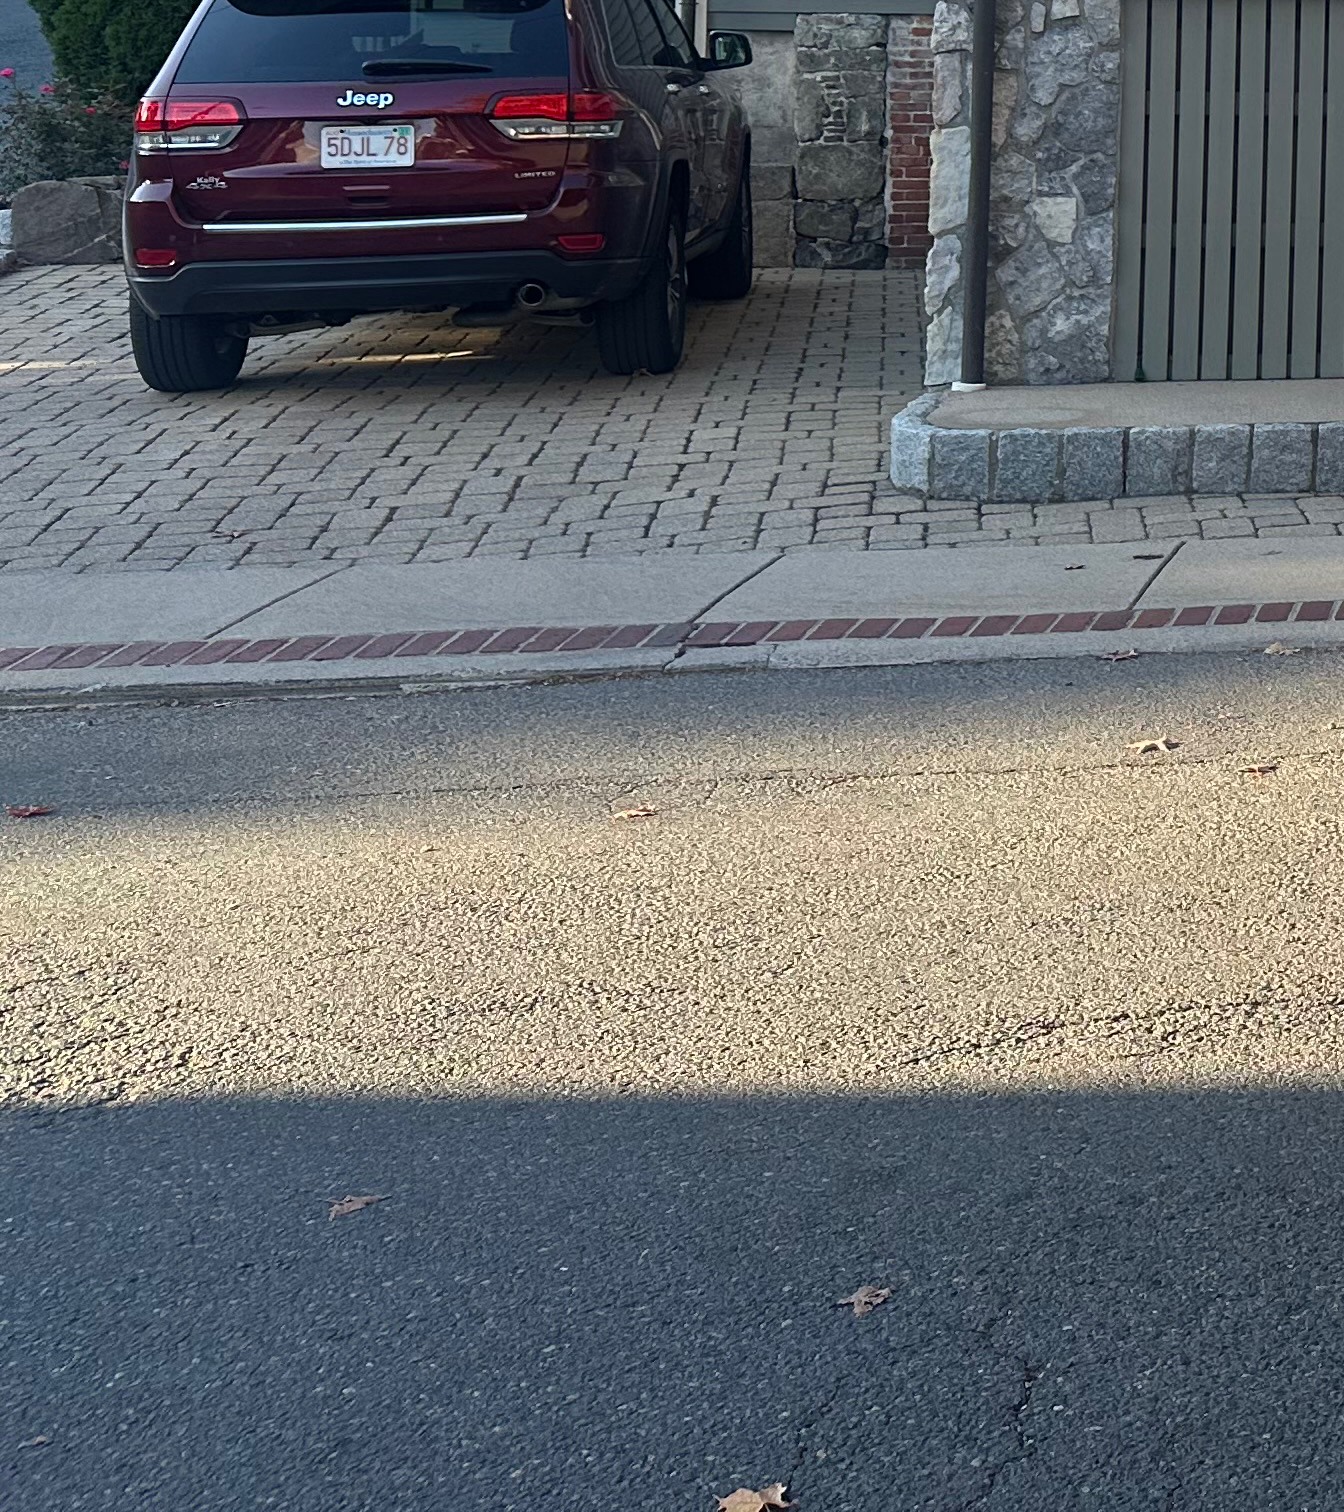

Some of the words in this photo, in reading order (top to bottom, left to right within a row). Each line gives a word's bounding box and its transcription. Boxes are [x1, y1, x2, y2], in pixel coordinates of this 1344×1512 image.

[336, 89, 394, 109] Jeep
[327, 136, 378, 157] 5DJL
[383, 135, 408, 156] 78
